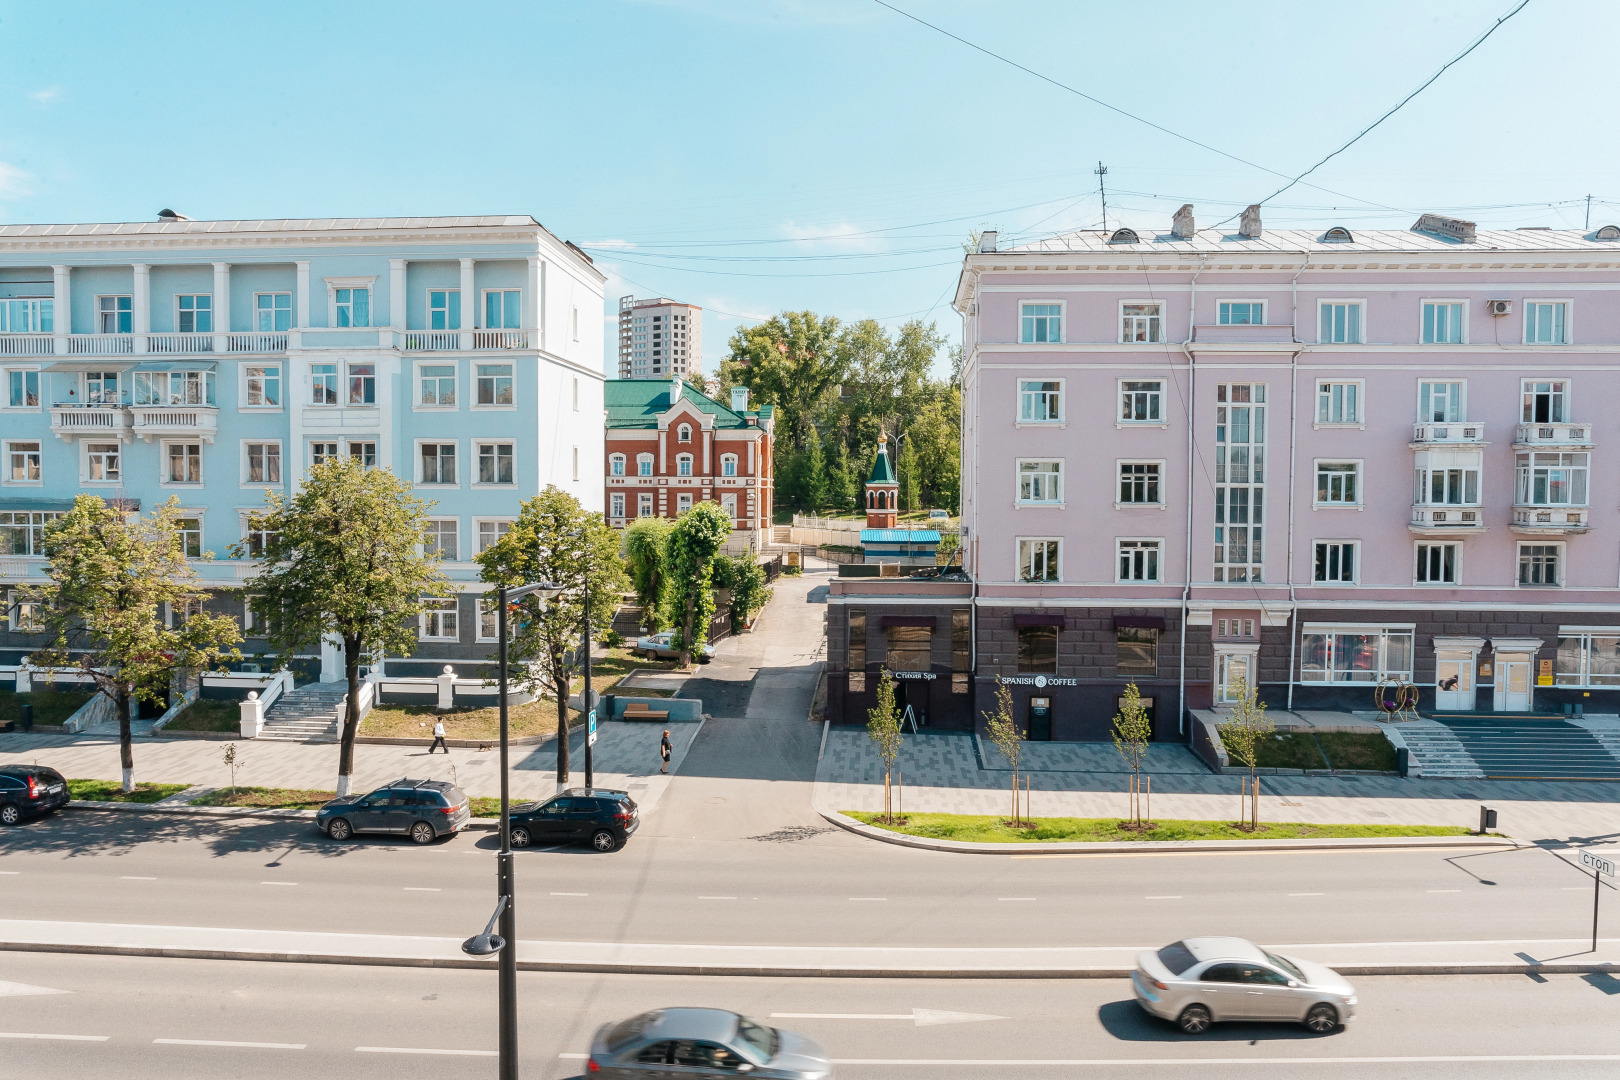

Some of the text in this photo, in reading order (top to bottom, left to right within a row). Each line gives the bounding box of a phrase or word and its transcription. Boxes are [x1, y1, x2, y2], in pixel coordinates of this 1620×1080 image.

[923, 672, 937, 681] Spa
[1001, 677, 1034, 685] SPANISH
[1048, 678, 1077, 686] COFFEE
[1583, 854, 1609, 872] СТОП
